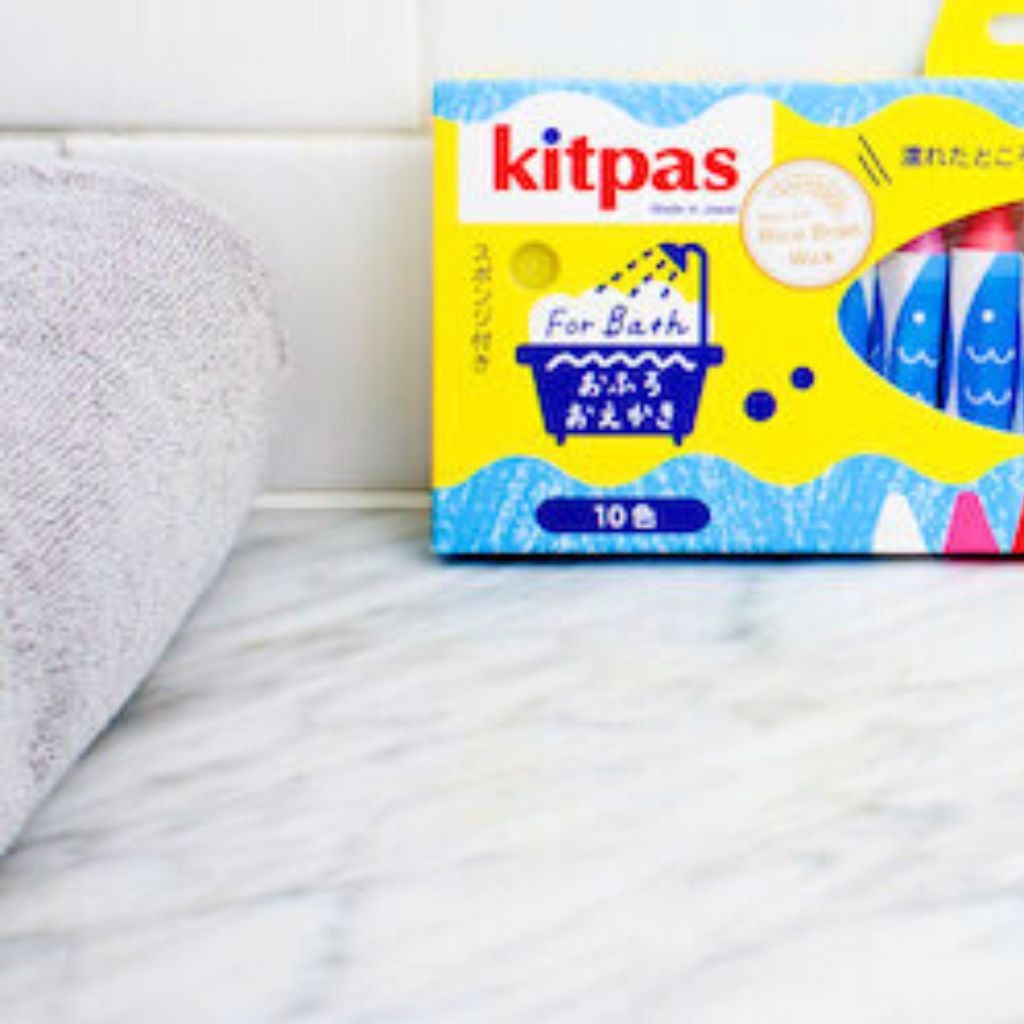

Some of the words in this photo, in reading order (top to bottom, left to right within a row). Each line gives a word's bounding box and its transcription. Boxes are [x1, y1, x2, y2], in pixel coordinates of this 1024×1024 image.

[493, 123, 740, 212] kitpas
[544, 306, 595, 338] For
[601, 304, 691, 339] Bath
[577, 370, 664, 398] おふろ
[564, 400, 676, 431] おえかき
[593, 503, 659, 530] 10色
